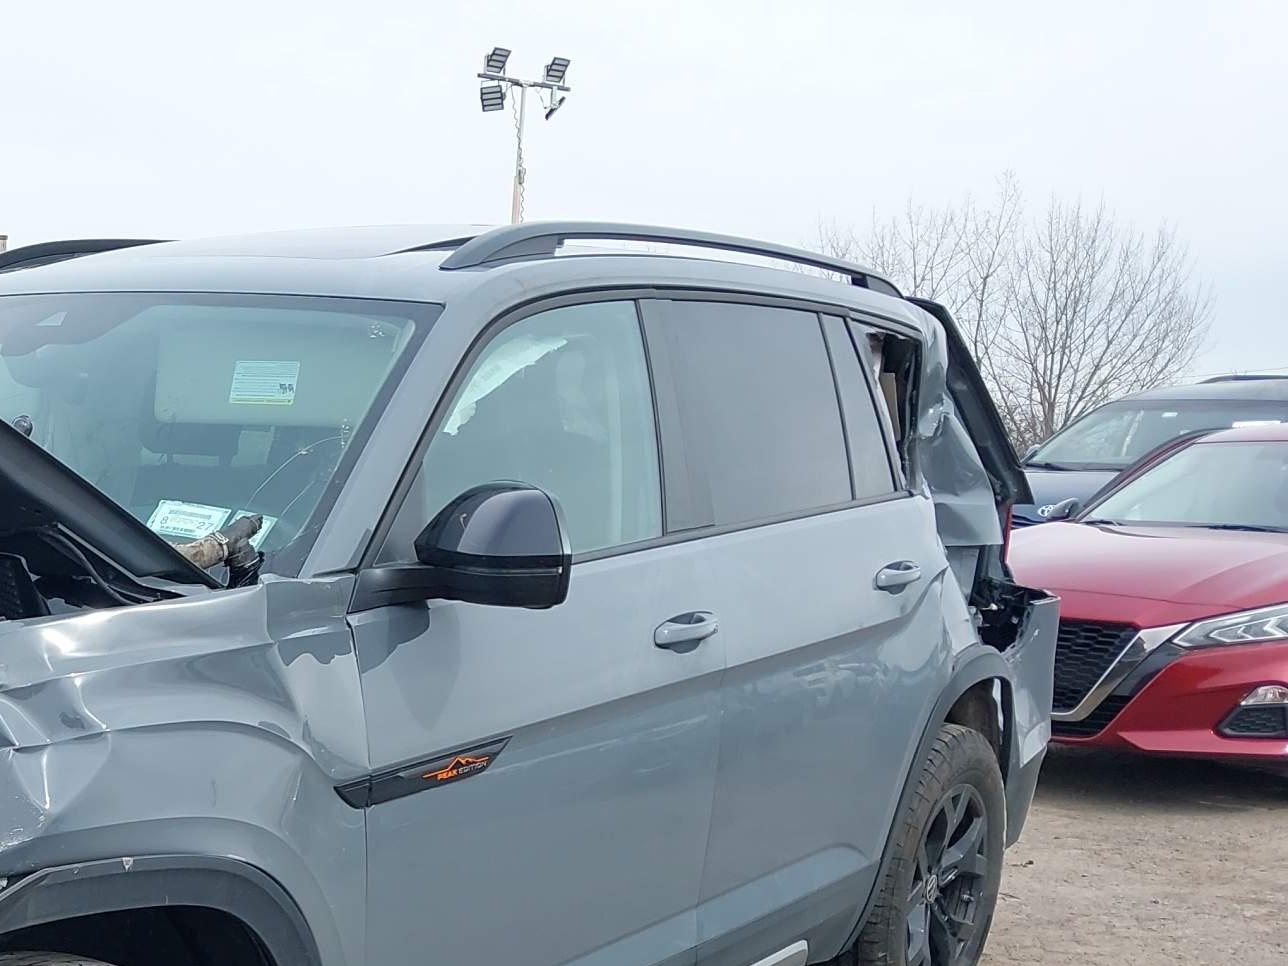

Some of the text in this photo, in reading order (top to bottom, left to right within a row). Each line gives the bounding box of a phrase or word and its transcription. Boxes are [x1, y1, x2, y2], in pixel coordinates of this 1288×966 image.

[159, 515, 169, 525] 8
[196, 521, 215, 531] 27
[437, 761, 488, 781] PEAK EDITION
